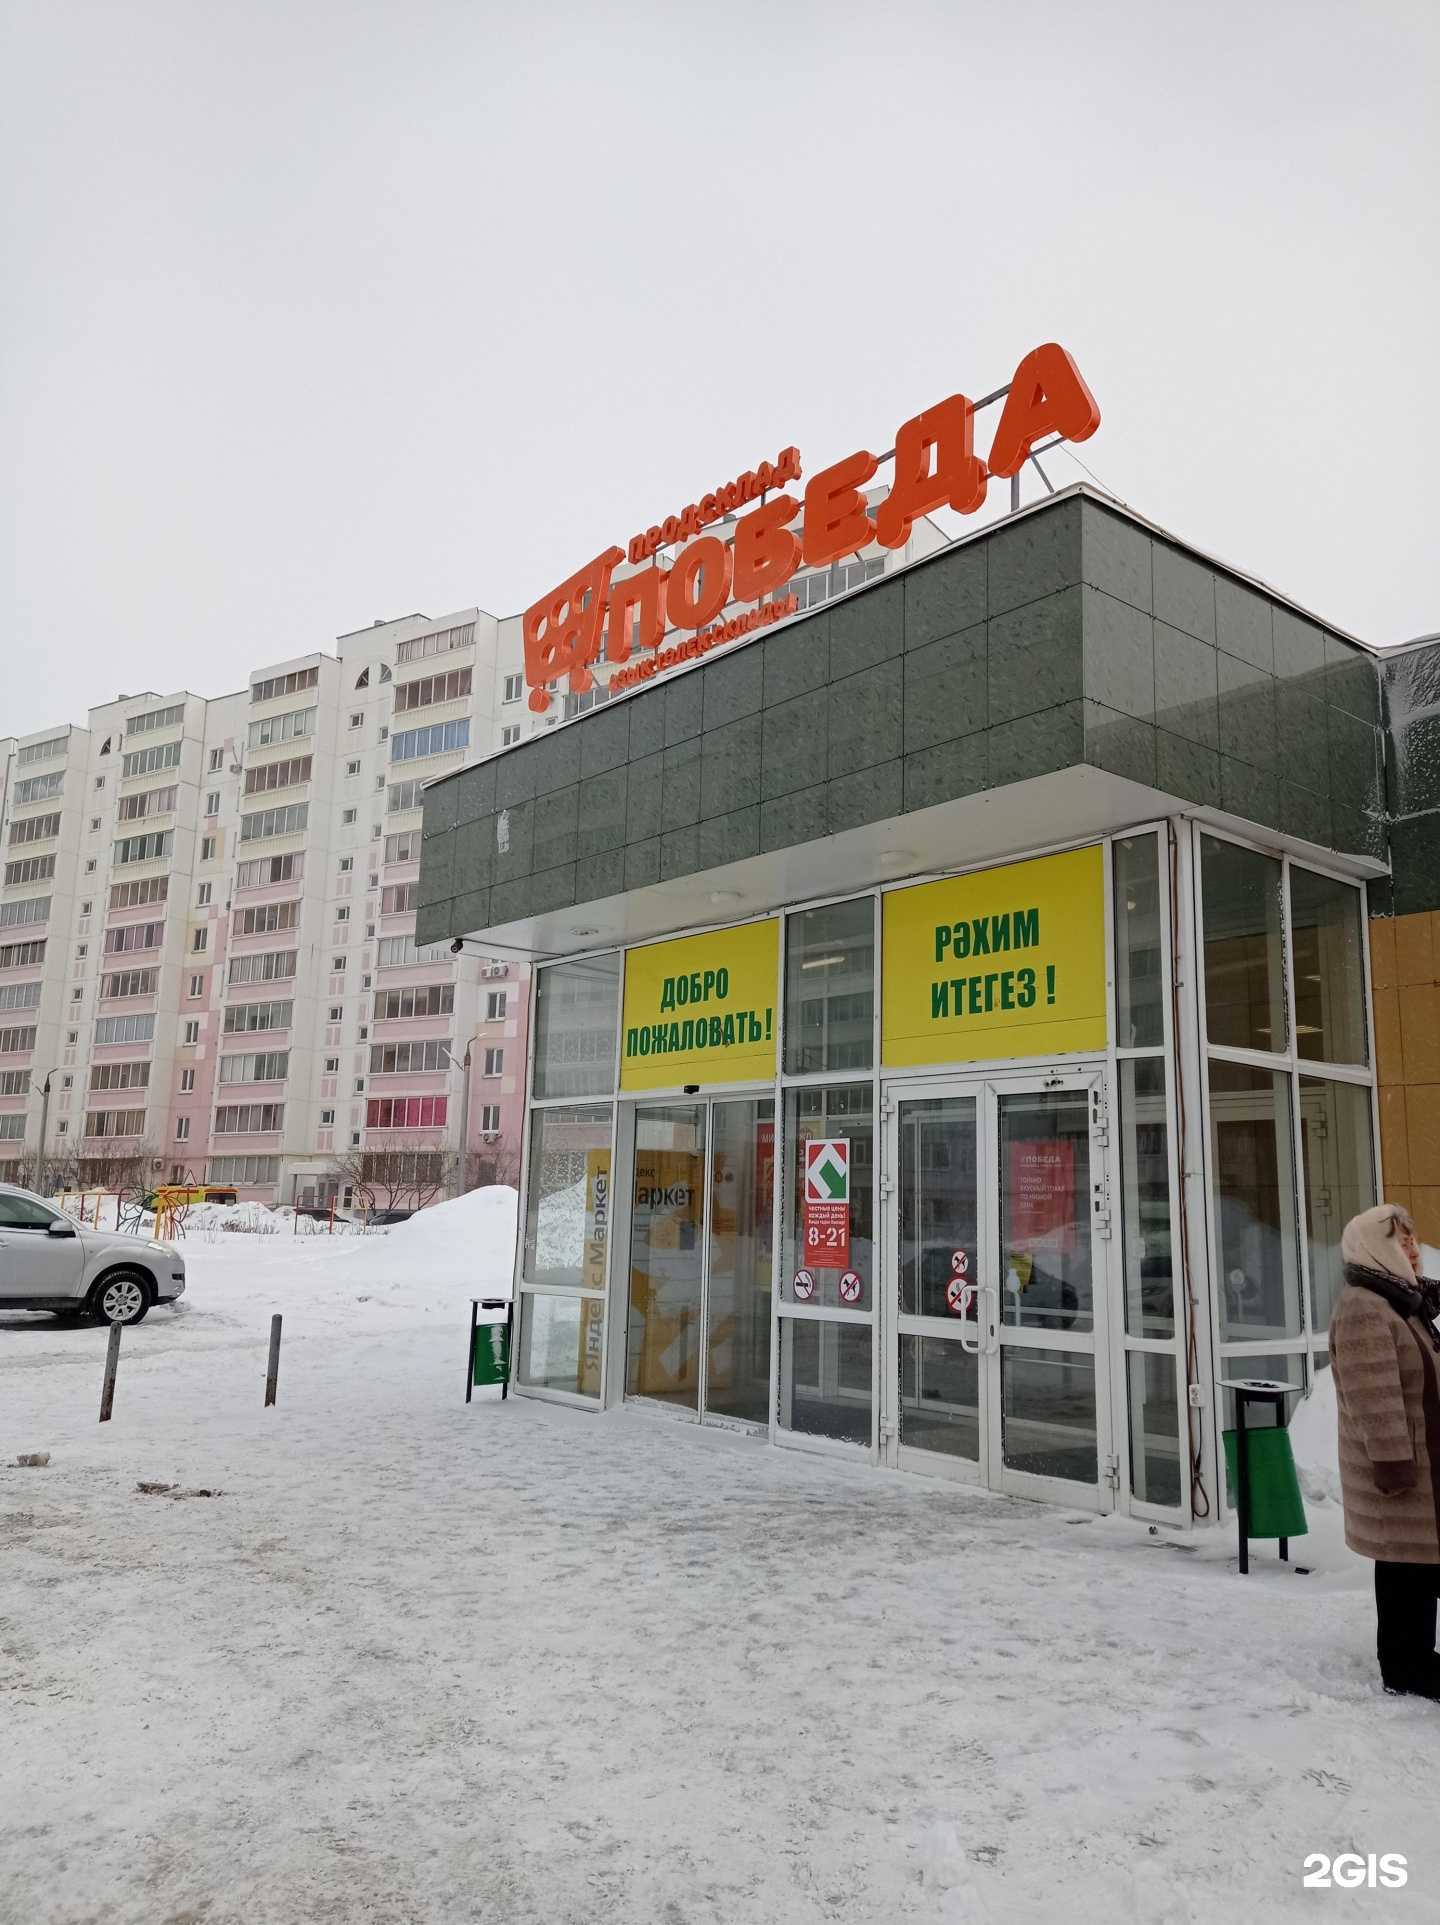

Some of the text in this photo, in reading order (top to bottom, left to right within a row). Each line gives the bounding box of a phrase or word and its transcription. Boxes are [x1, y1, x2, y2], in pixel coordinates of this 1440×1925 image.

[606, 342, 1101, 664] ПОБЕДА
[628, 446, 802, 564] ПРОДСКЛАД
[935, 908, 1040, 963] РӘХИМ
[660, 967, 729, 1013] ДОБРО
[626, 1008, 773, 1057] ПОЖАЛОВАТЬ!
[590, 1166, 608, 1263] Маркет
[635, 1180, 695, 1210] аркет
[808, 1226, 846, 1248] 8-21
